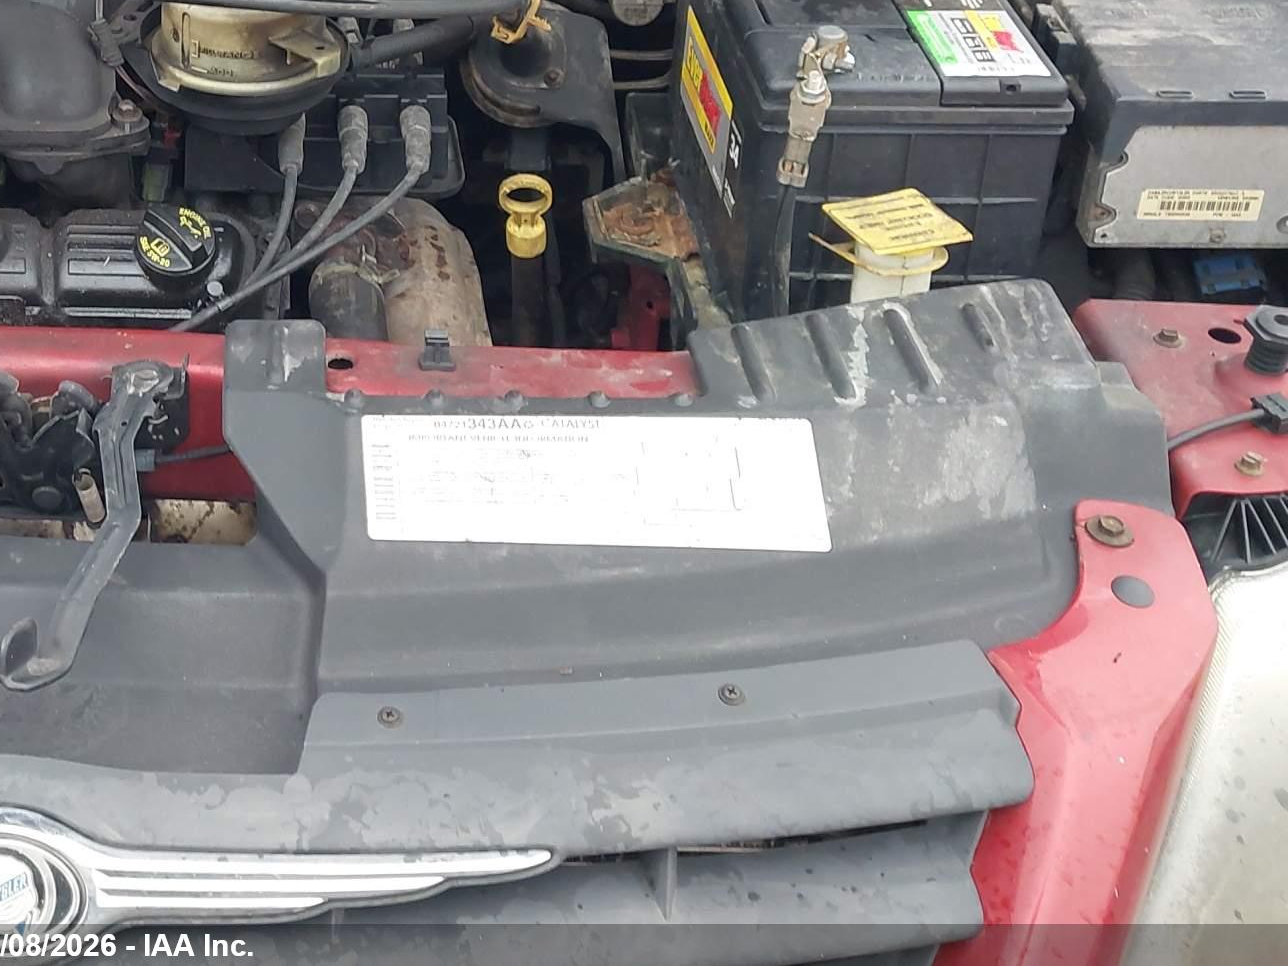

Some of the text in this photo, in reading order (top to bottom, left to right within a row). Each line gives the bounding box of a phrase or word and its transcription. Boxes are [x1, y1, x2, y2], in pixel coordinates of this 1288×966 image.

[729, 132, 740, 169] 34
[179, 207, 212, 240] ENGINE OIL
[139, 236, 170, 268] SEE 5W-20
